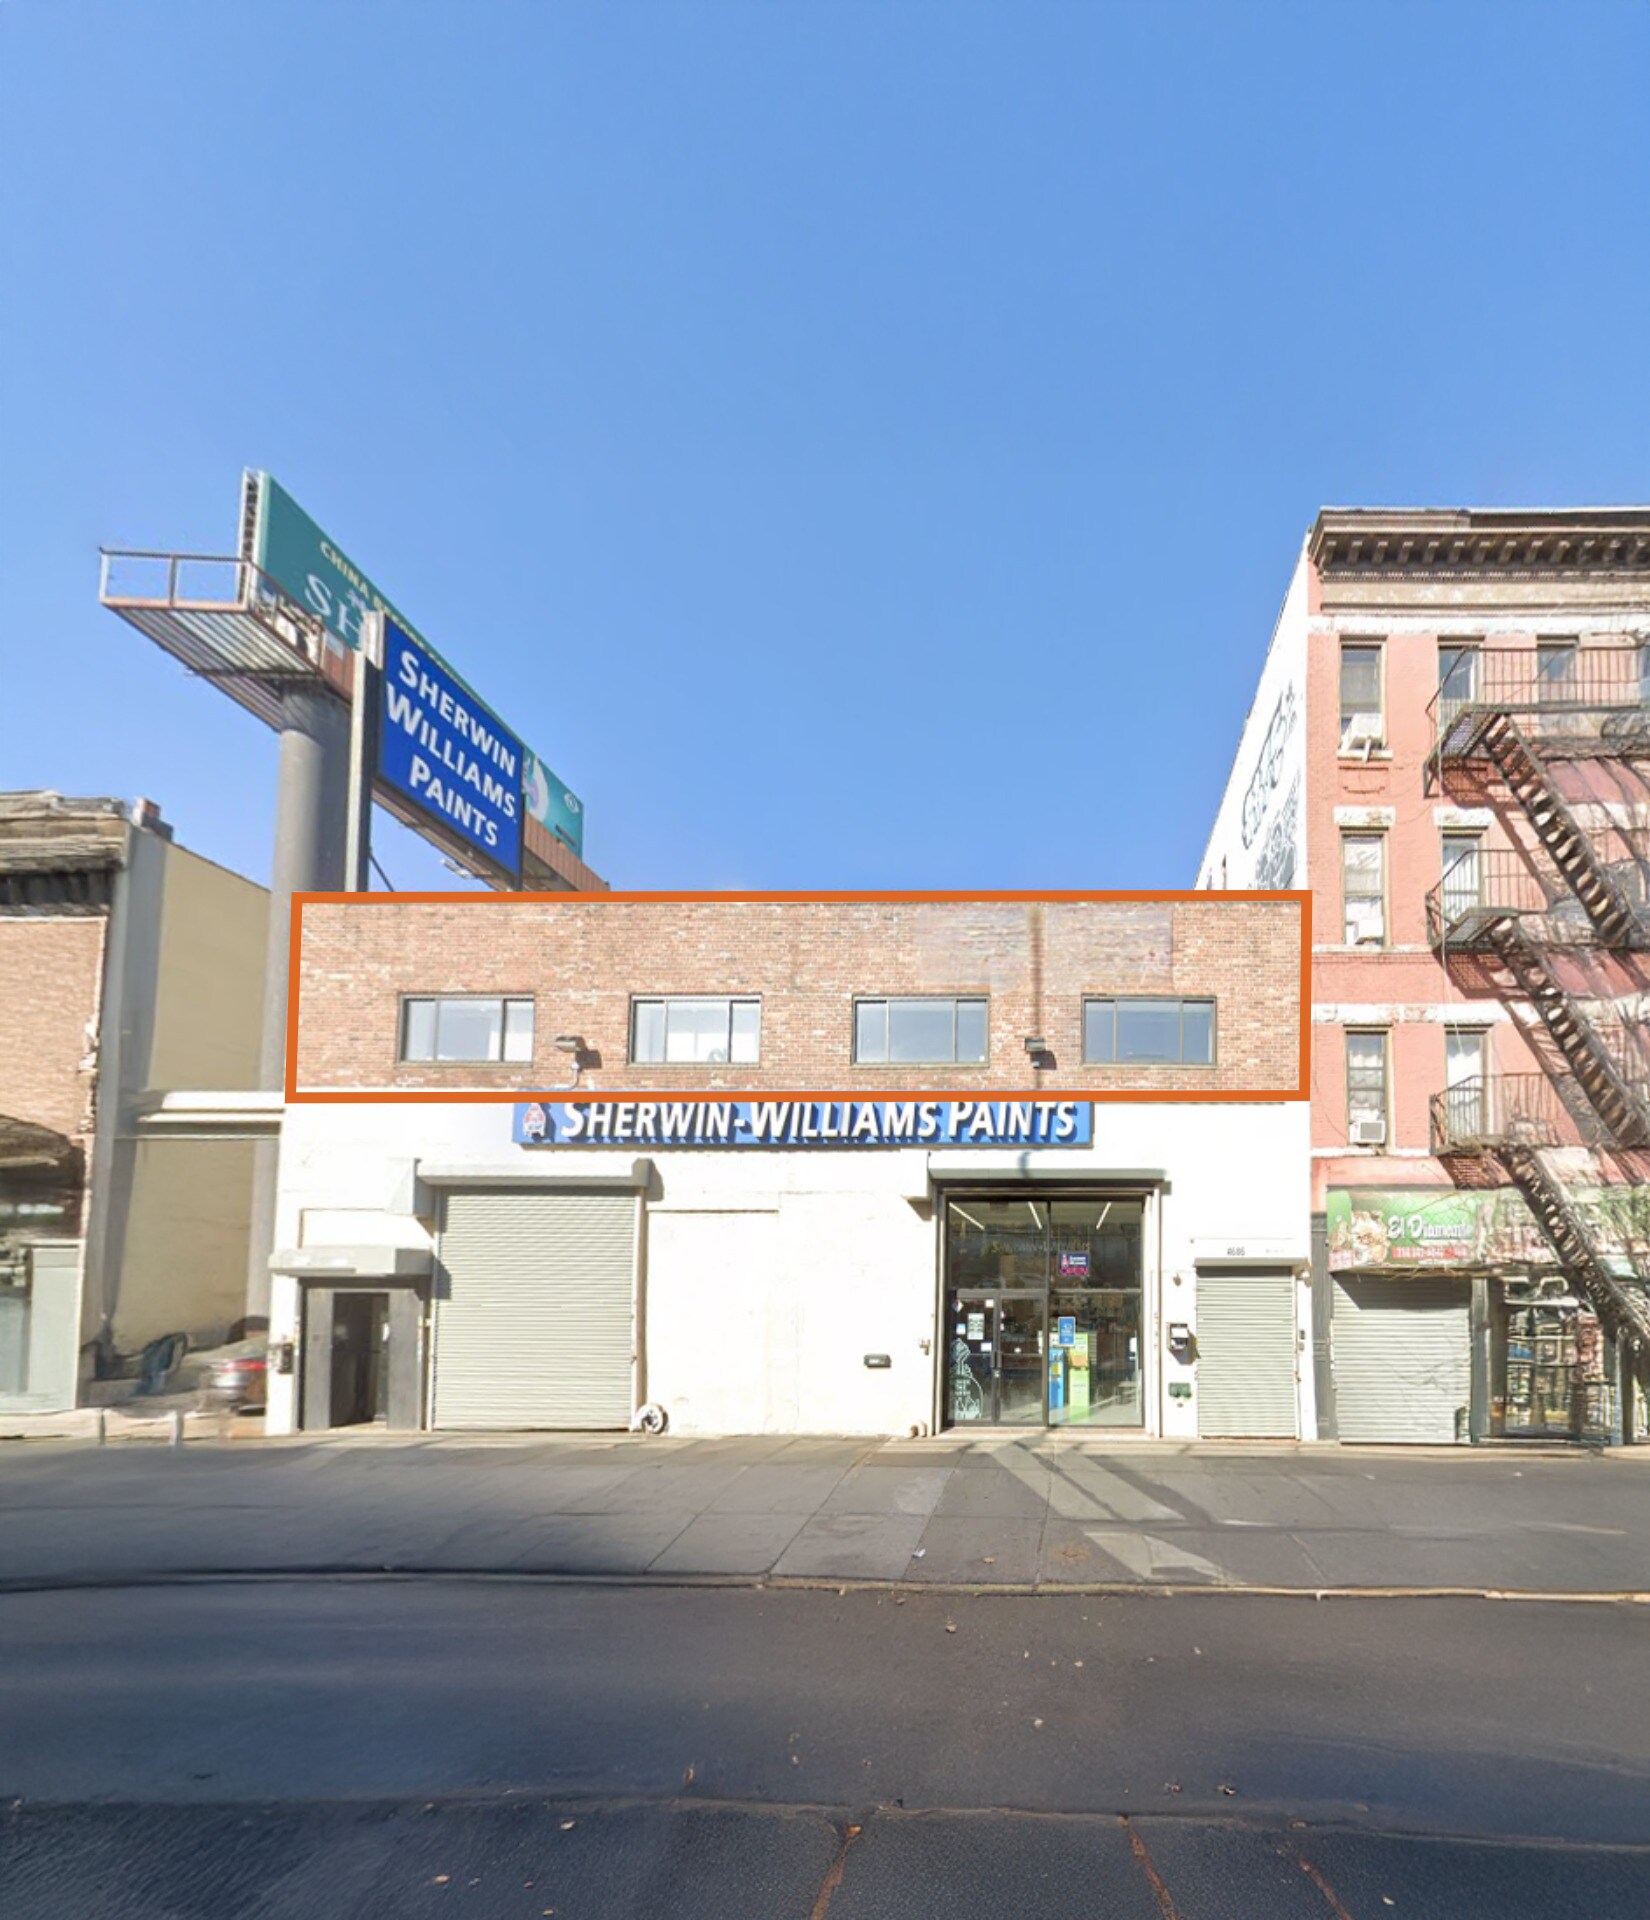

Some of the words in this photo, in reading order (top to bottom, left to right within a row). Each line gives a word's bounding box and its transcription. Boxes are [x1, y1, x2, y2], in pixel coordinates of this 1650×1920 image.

[387, 681, 515, 818] WILLIAMS
[399, 649, 516, 778] SHERWIN
[409, 754, 498, 846] PAINTS
[561, 1102, 937, 1137] SHERWIN-WILLIAMS
[949, 1102, 1074, 1137] PAINTS
[1388, 1205, 1404, 1238] El
